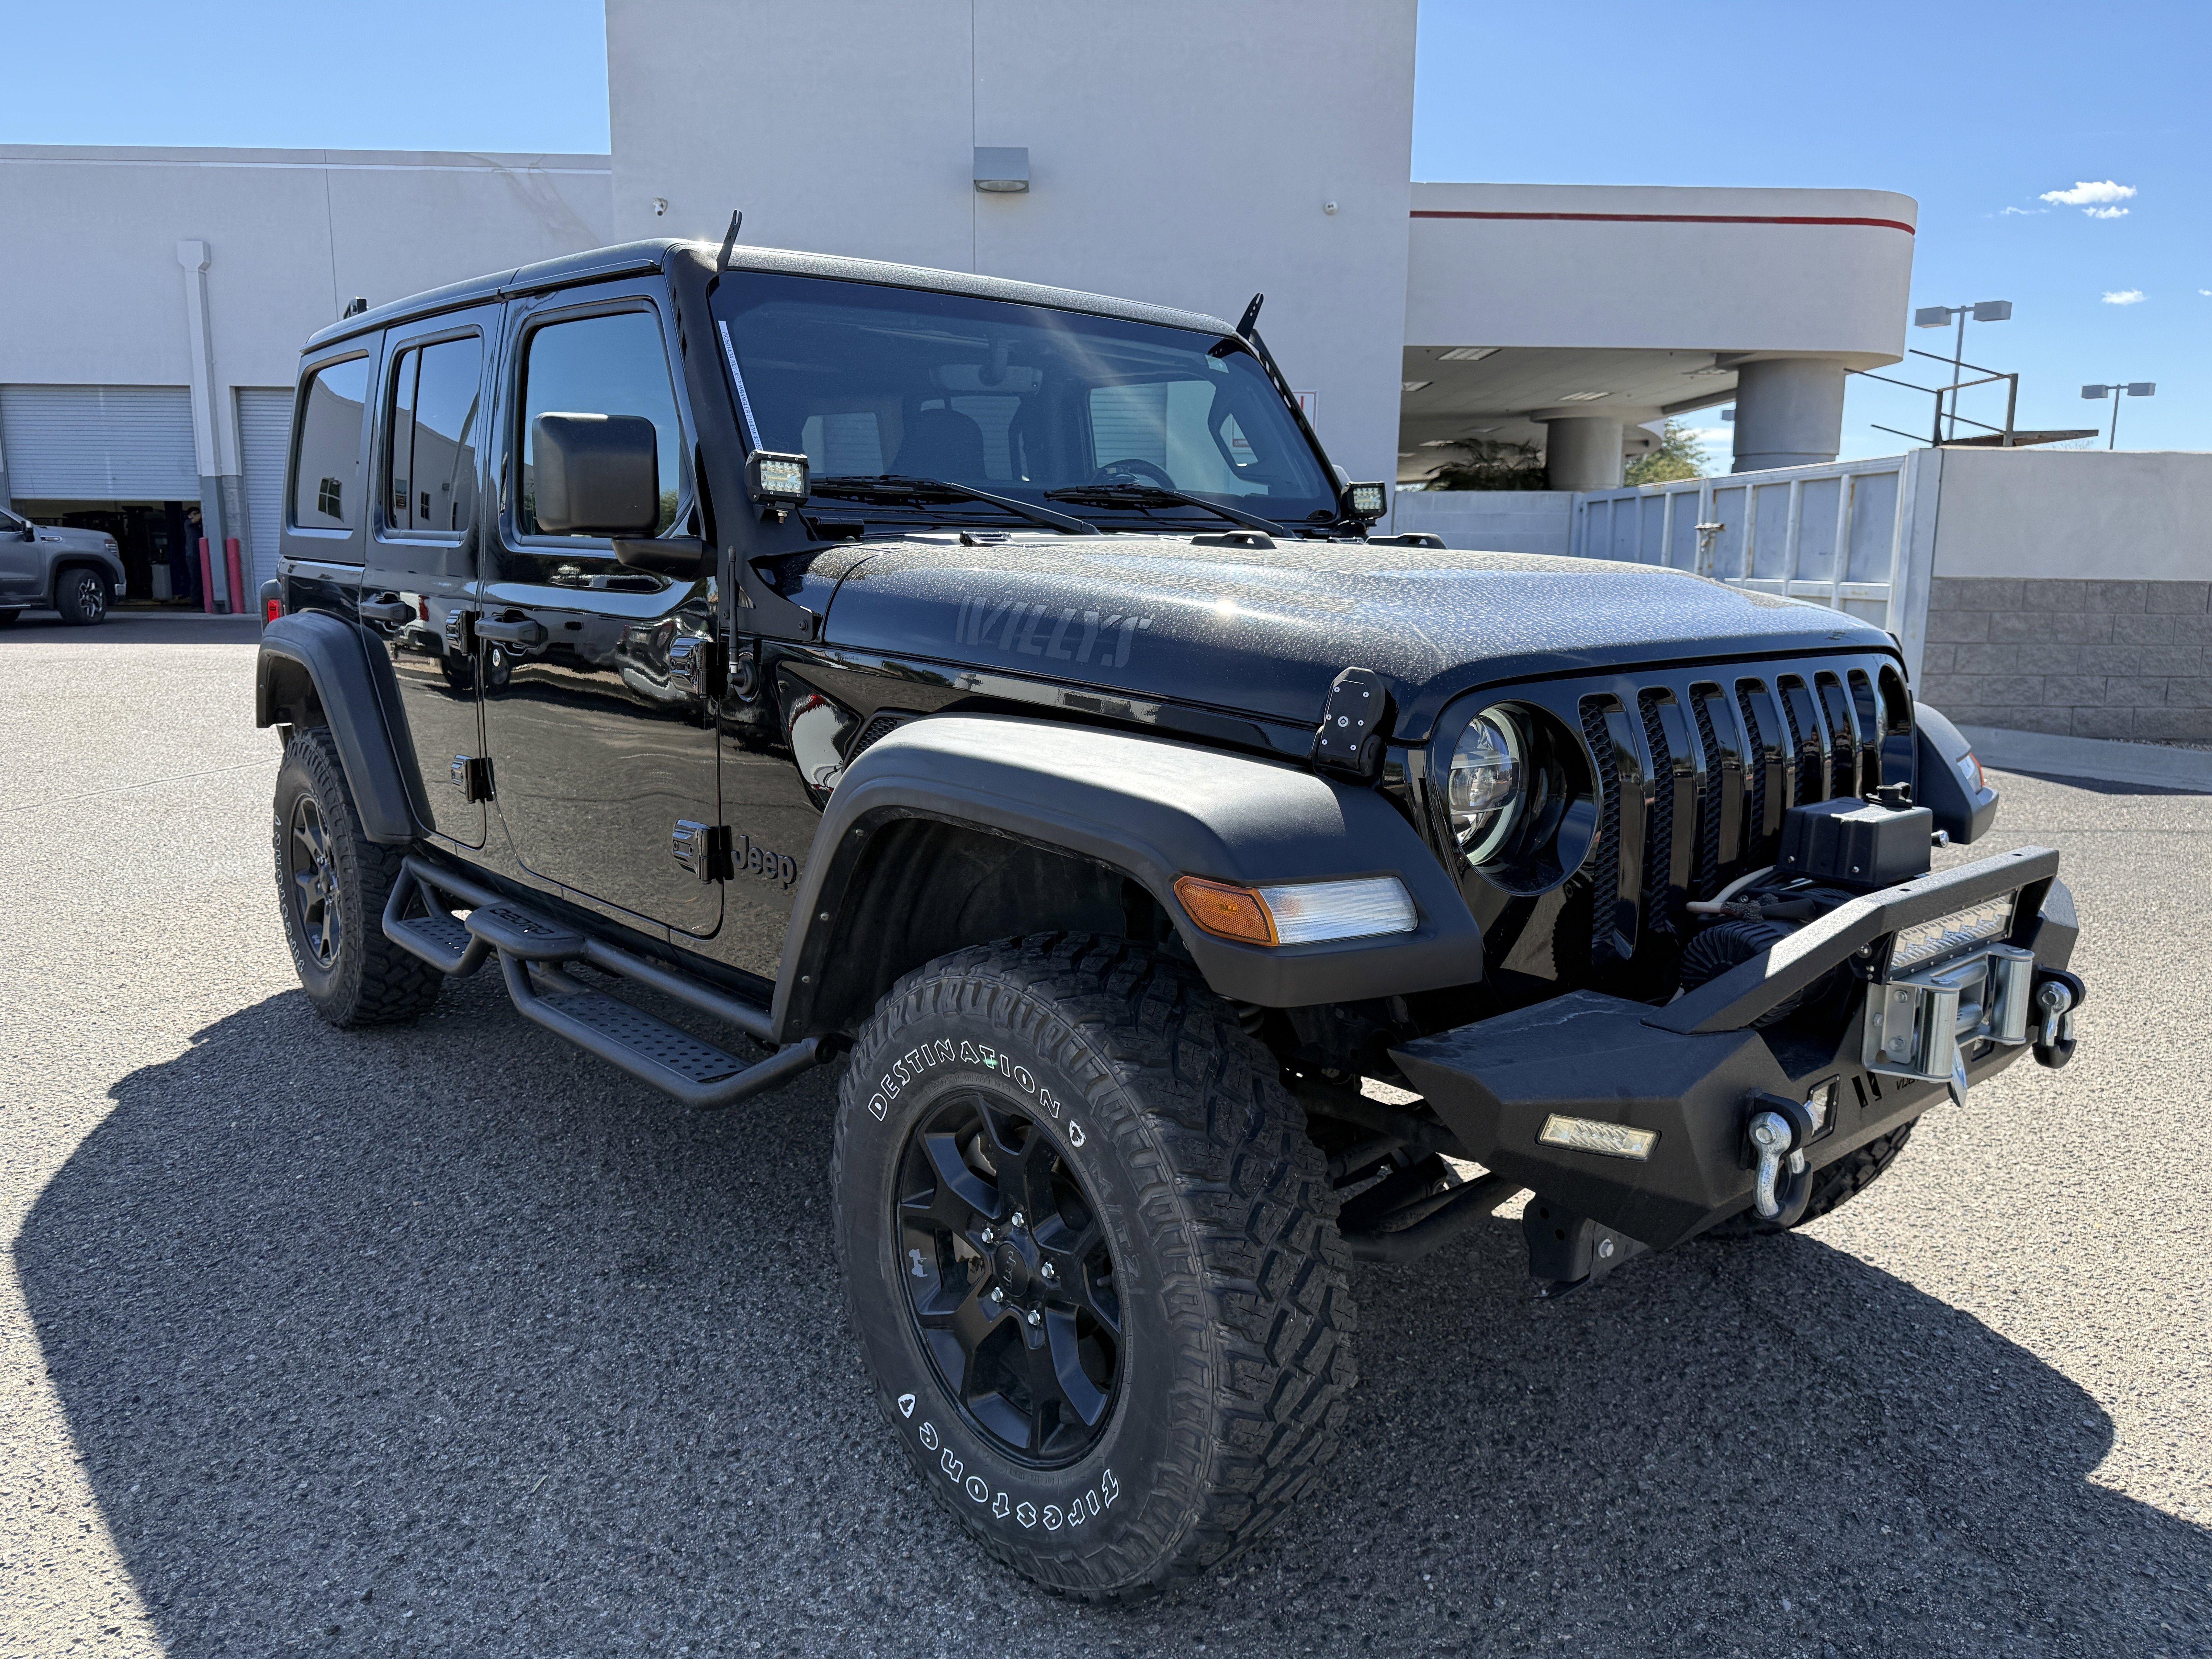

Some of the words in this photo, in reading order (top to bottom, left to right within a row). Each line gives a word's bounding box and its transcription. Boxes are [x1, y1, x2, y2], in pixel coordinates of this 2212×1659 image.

[738, 385, 750, 414] WRANGLER
[955, 595, 1152, 668] WILLYS
[731, 835, 797, 890] Jeep
[868, 1038, 1060, 1121] DESTINATION
[919, 1422, 1119, 1530] Firestone
